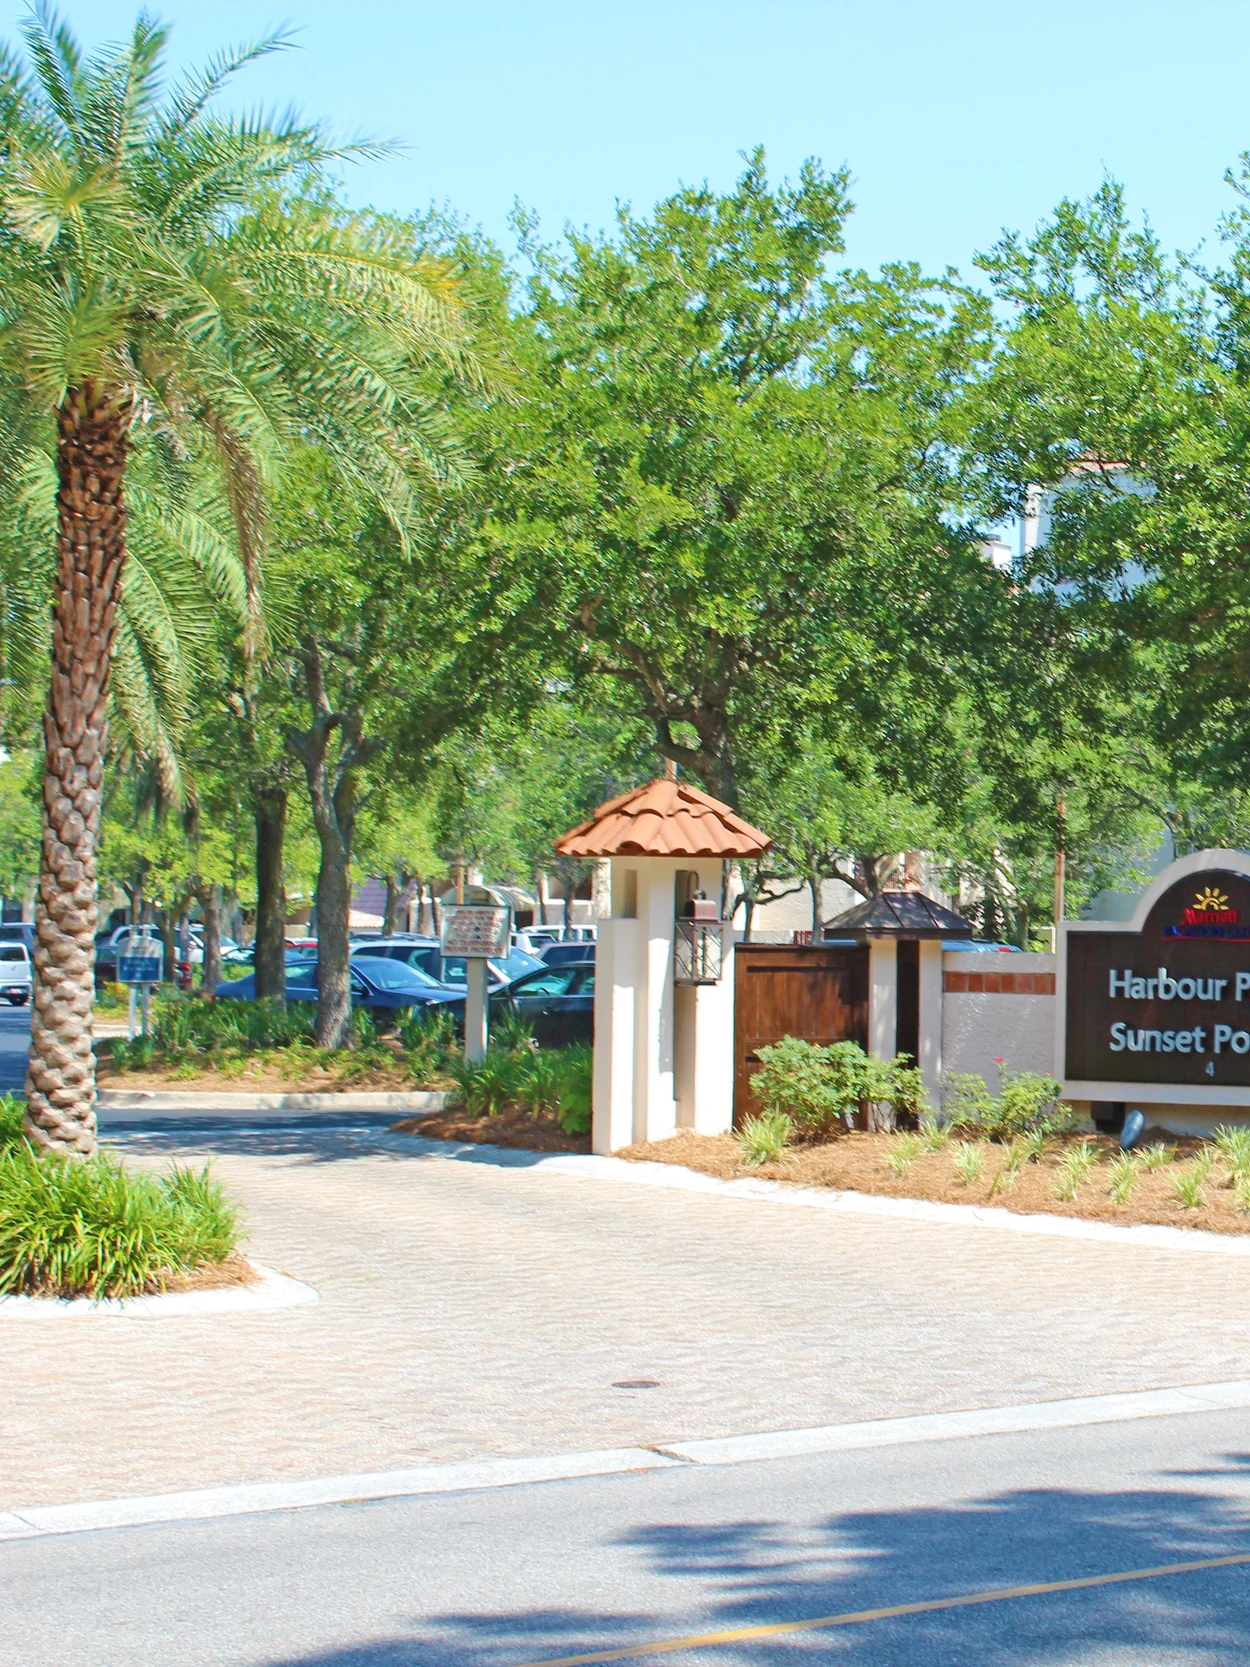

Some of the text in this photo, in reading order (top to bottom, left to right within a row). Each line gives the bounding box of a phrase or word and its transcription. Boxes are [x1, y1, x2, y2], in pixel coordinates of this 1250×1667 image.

[1180, 908, 1239, 925] Marriott
[1109, 967, 1227, 1001] Harbour
[1109, 1022, 1206, 1054] Sunset
[1204, 1061, 1216, 1077] 4
